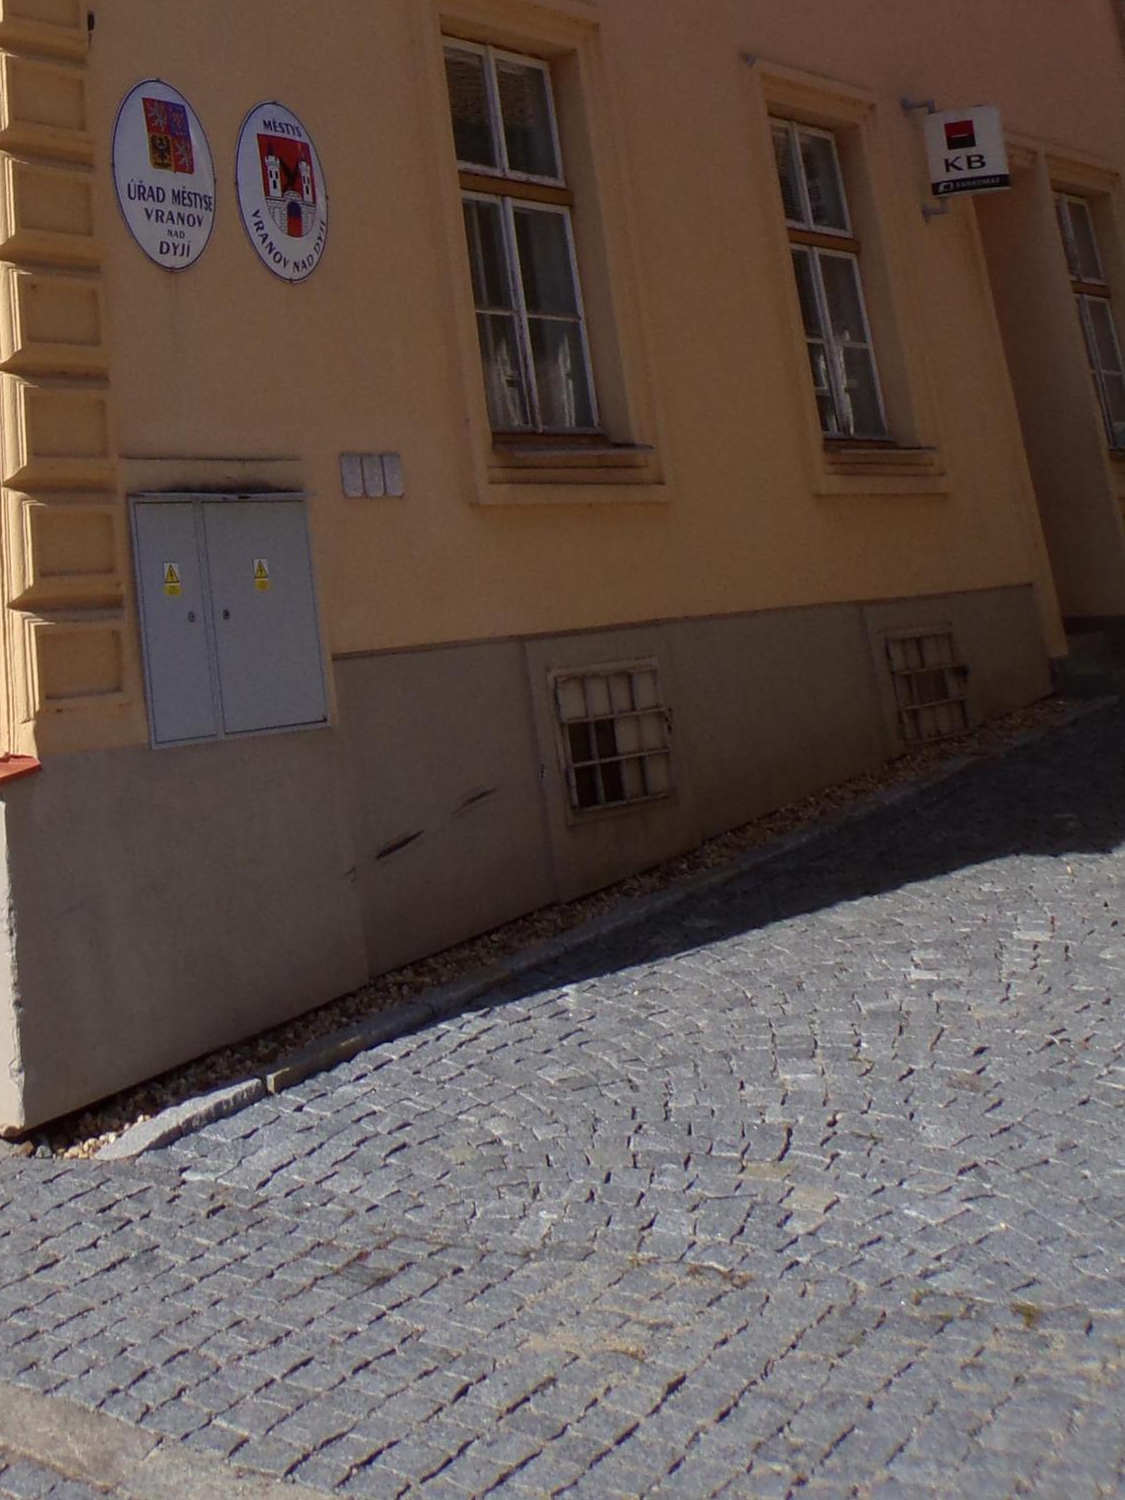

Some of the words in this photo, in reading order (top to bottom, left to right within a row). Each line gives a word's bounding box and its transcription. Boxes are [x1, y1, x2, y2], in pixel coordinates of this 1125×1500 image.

[944, 154, 987, 173] KB
[127, 178, 166, 204] ÚŘAD
[172, 185, 214, 212] MĚSTYSE
[143, 207, 204, 228] VRANOV
[167, 229, 186, 239] NAD
[251, 209, 290, 268] VRANOV
[292, 253, 315, 274] NAD
[159, 240, 192, 258] DYJÍ
